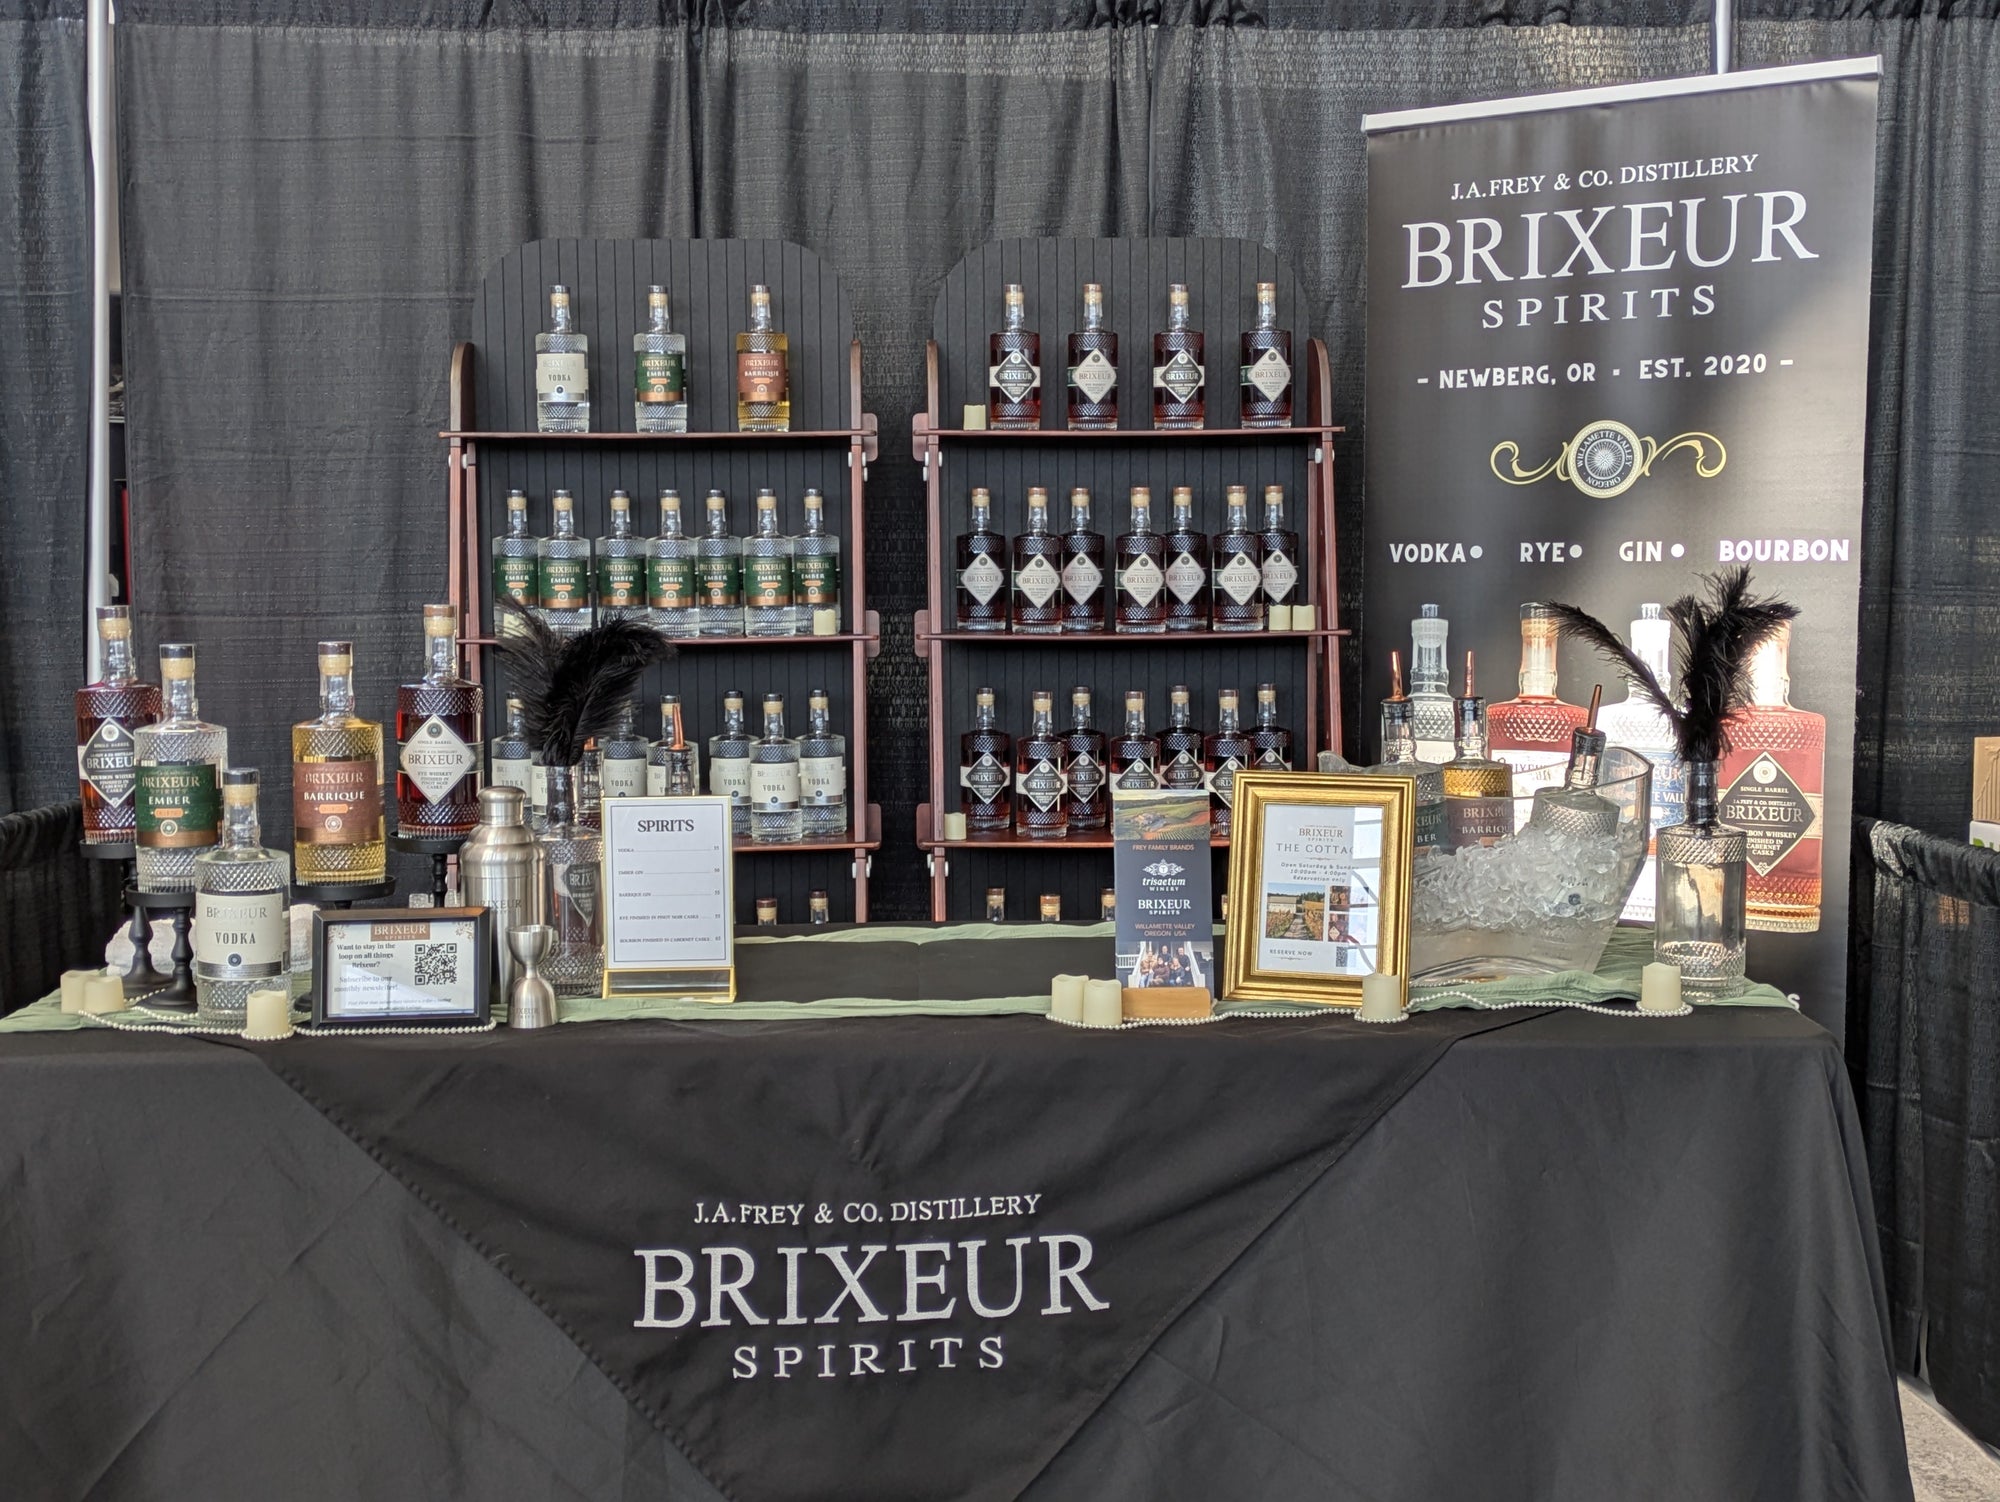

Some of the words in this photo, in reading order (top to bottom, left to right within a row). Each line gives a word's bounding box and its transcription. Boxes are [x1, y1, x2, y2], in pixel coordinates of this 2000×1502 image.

[1554, 173, 1570, 191] &
[1578, 169, 1613, 188] CO.
[1620, 154, 1758, 185] DISTILLERY
[1401, 190, 1819, 289] BRIXEUR
[1482, 285, 1715, 328] SPIRITS
[647, 370, 671, 378] EMBER
[744, 370, 779, 378] BARRIQUE
[1439, 364, 1556, 389] NEWBERG,
[1567, 363, 1595, 382] OR
[1639, 358, 1692, 380] EST.
[1704, 354, 1767, 376] 2020
[548, 374, 571, 382] VODKA
[1577, 431, 1615, 467] WILLAMETTE
[1617, 434, 1632, 467] VALLEY
[1586, 476, 1621, 488] OREGON
[1389, 543, 1465, 563] VODKA
[1519, 542, 1565, 562] RYE
[1619, 541, 1662, 561] GIN
[1718, 540, 1849, 562] BOURBON
[86, 756, 133, 769] BRIXEU
[408, 753, 463, 765] BRIXEUR
[142, 776, 200, 788] BRIXEUR
[305, 772, 364, 784] BRIXEUR
[762, 784, 786, 792] VODKA
[148, 796, 191, 805] EMBER
[304, 791, 365, 802] BARRIQUE
[1726, 805, 1803, 822] BRIXEUR
[637, 819, 695, 832] SPIRITS
[1299, 828, 1343, 838] BRIXEUR
[1765, 831, 1798, 839] WHISKEY
[1276, 843, 1300, 852] THE
[1142, 877, 1186, 886] trisaetum
[1138, 899, 1191, 909] BRIXEUR
[374, 924, 427, 936] BRIXEUR
[215, 932, 256, 944] VODKA
[815, 1205, 833, 1224] &
[843, 1202, 883, 1223] CO.
[890, 1194, 1041, 1222] DISTILLERY
[633, 1234, 1110, 1328] BRIXEUR
[733, 1336, 1004, 1379] SPIRITS
